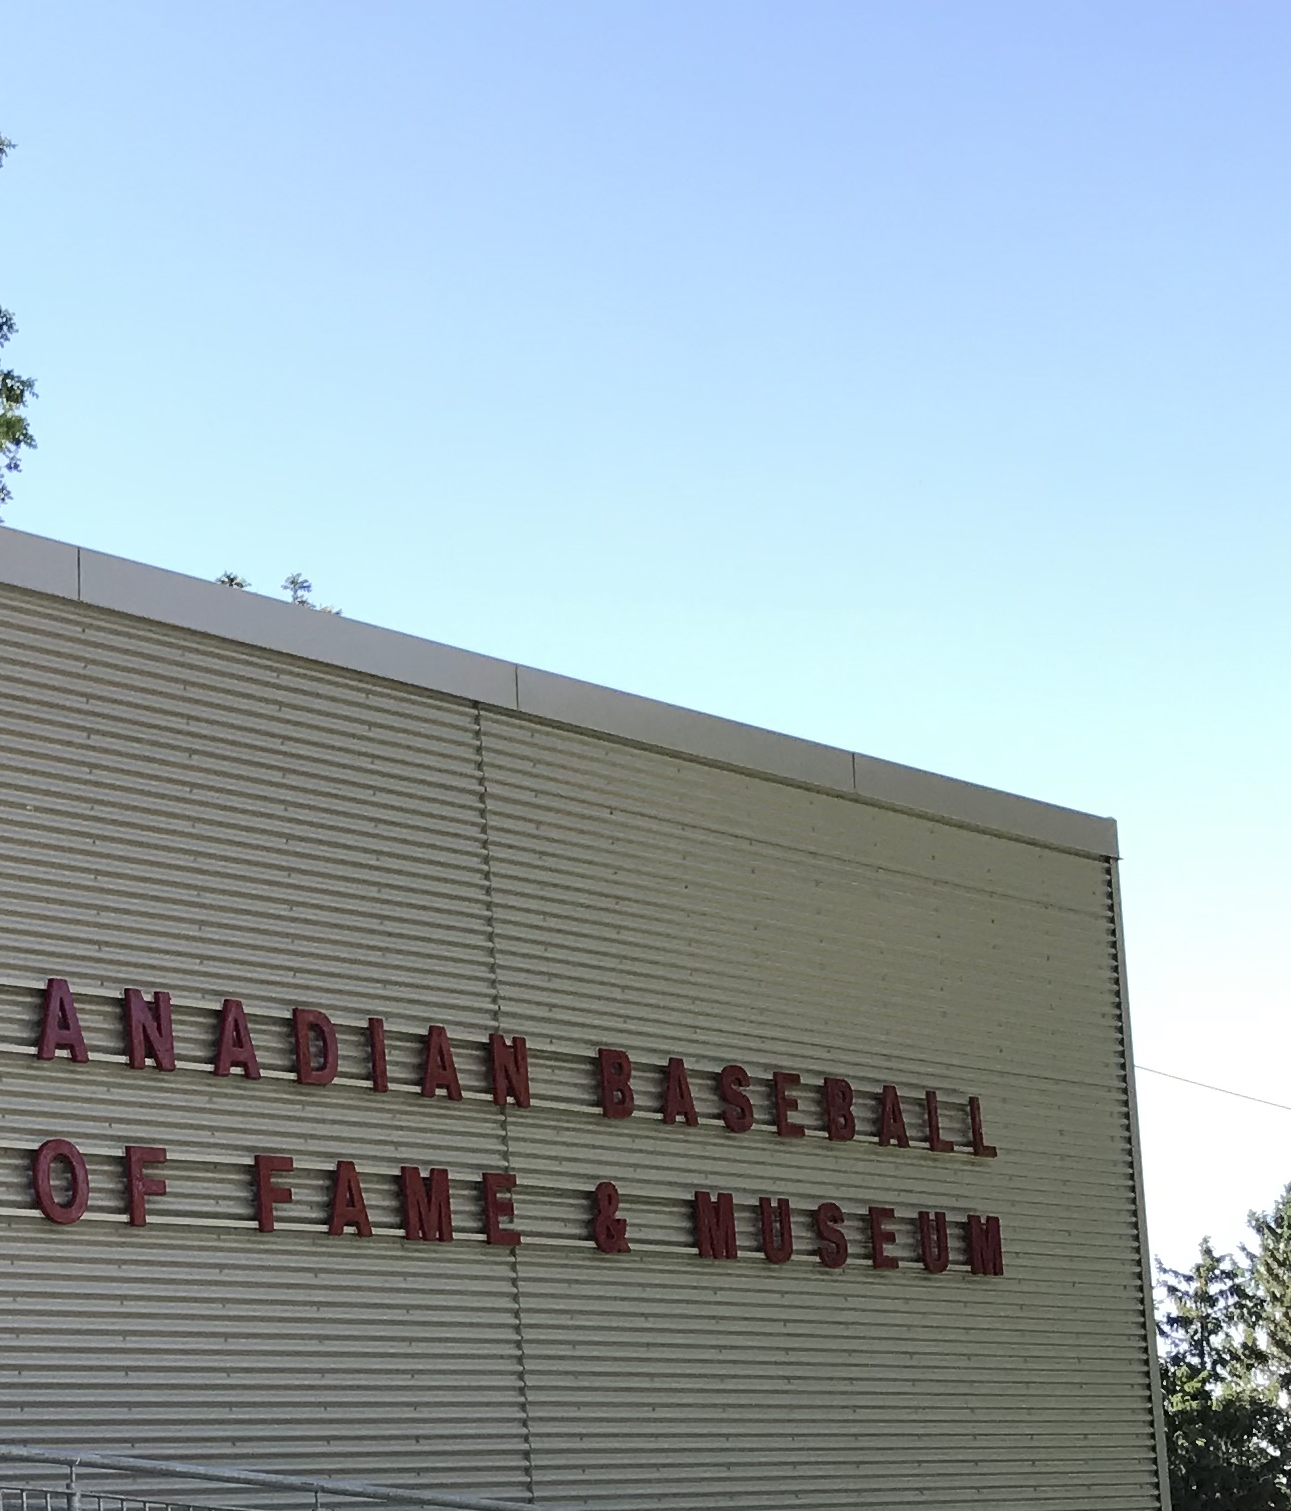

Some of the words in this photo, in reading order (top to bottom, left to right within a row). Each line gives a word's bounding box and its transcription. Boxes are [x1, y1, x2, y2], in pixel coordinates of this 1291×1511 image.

[598, 1047, 998, 1157] BASEBALL
[32, 1138, 167, 1227] OF
[254, 1154, 522, 1246] FAME
[594, 1181, 631, 1254] &
[694, 1190, 1005, 1276] MUSEUM
